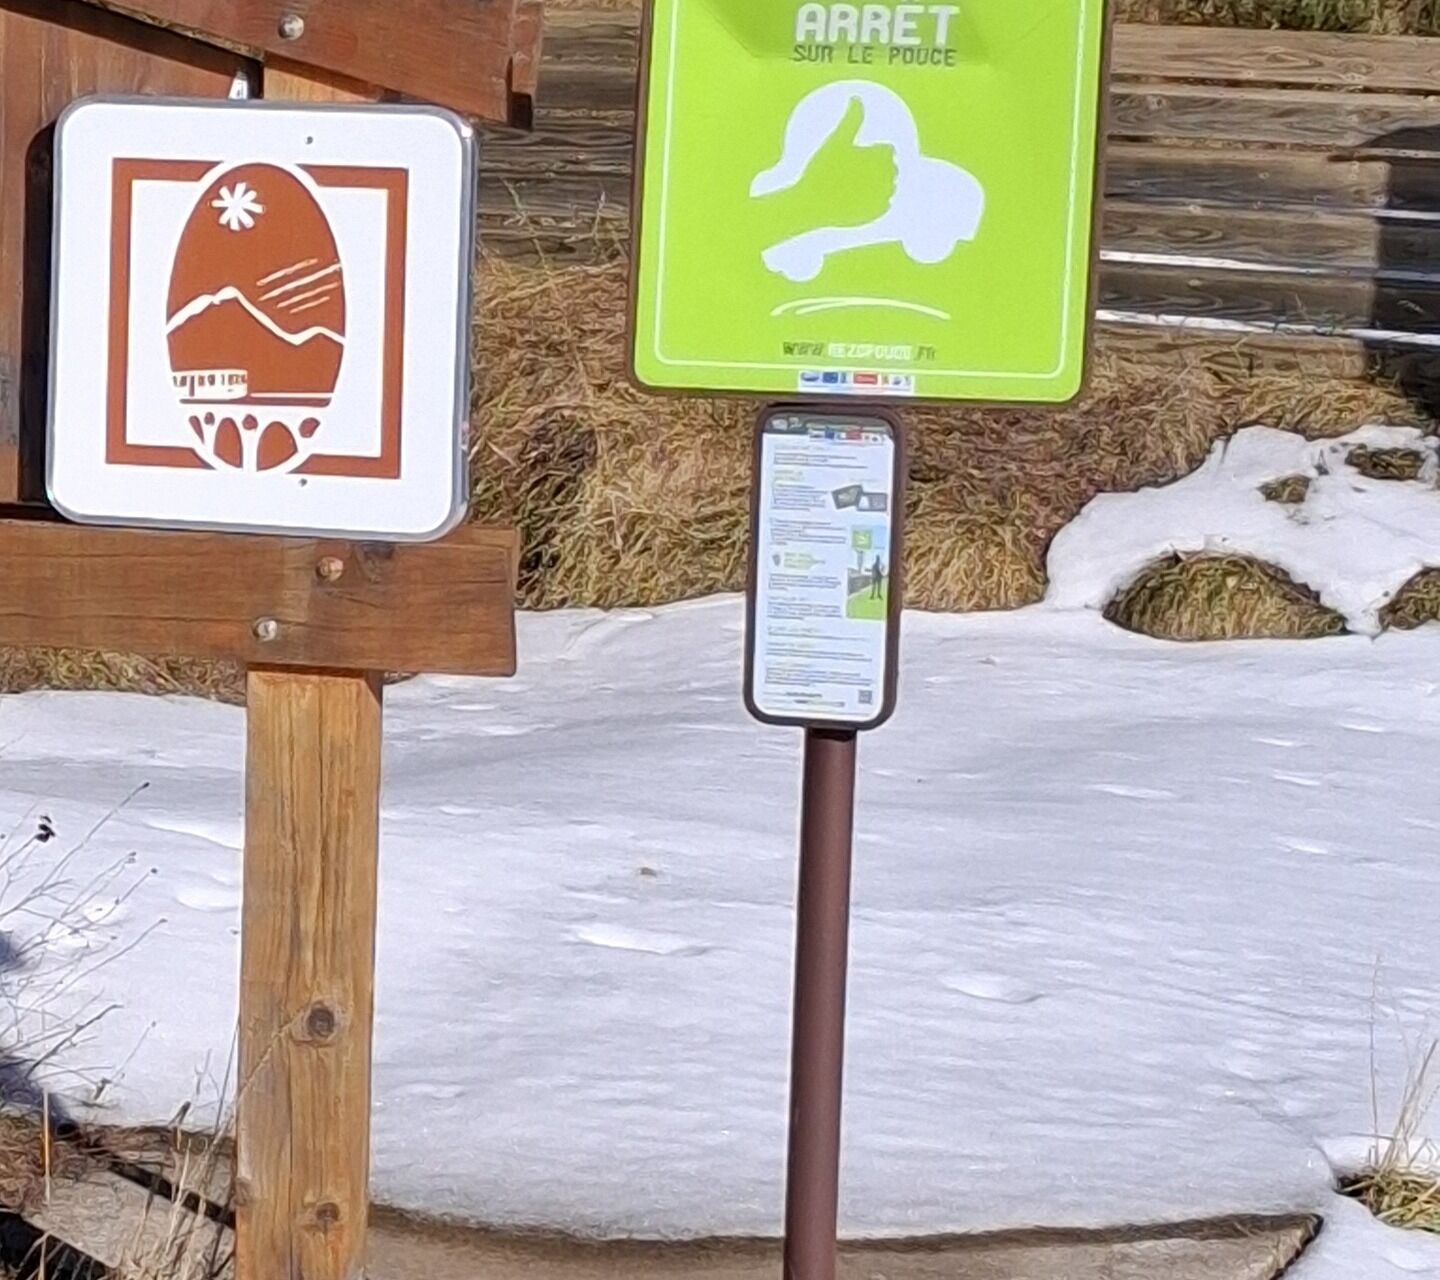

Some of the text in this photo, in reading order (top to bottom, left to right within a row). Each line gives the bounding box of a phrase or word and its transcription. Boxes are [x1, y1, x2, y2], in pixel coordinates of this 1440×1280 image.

[792, 43, 958, 67] SUR LE POUCE
